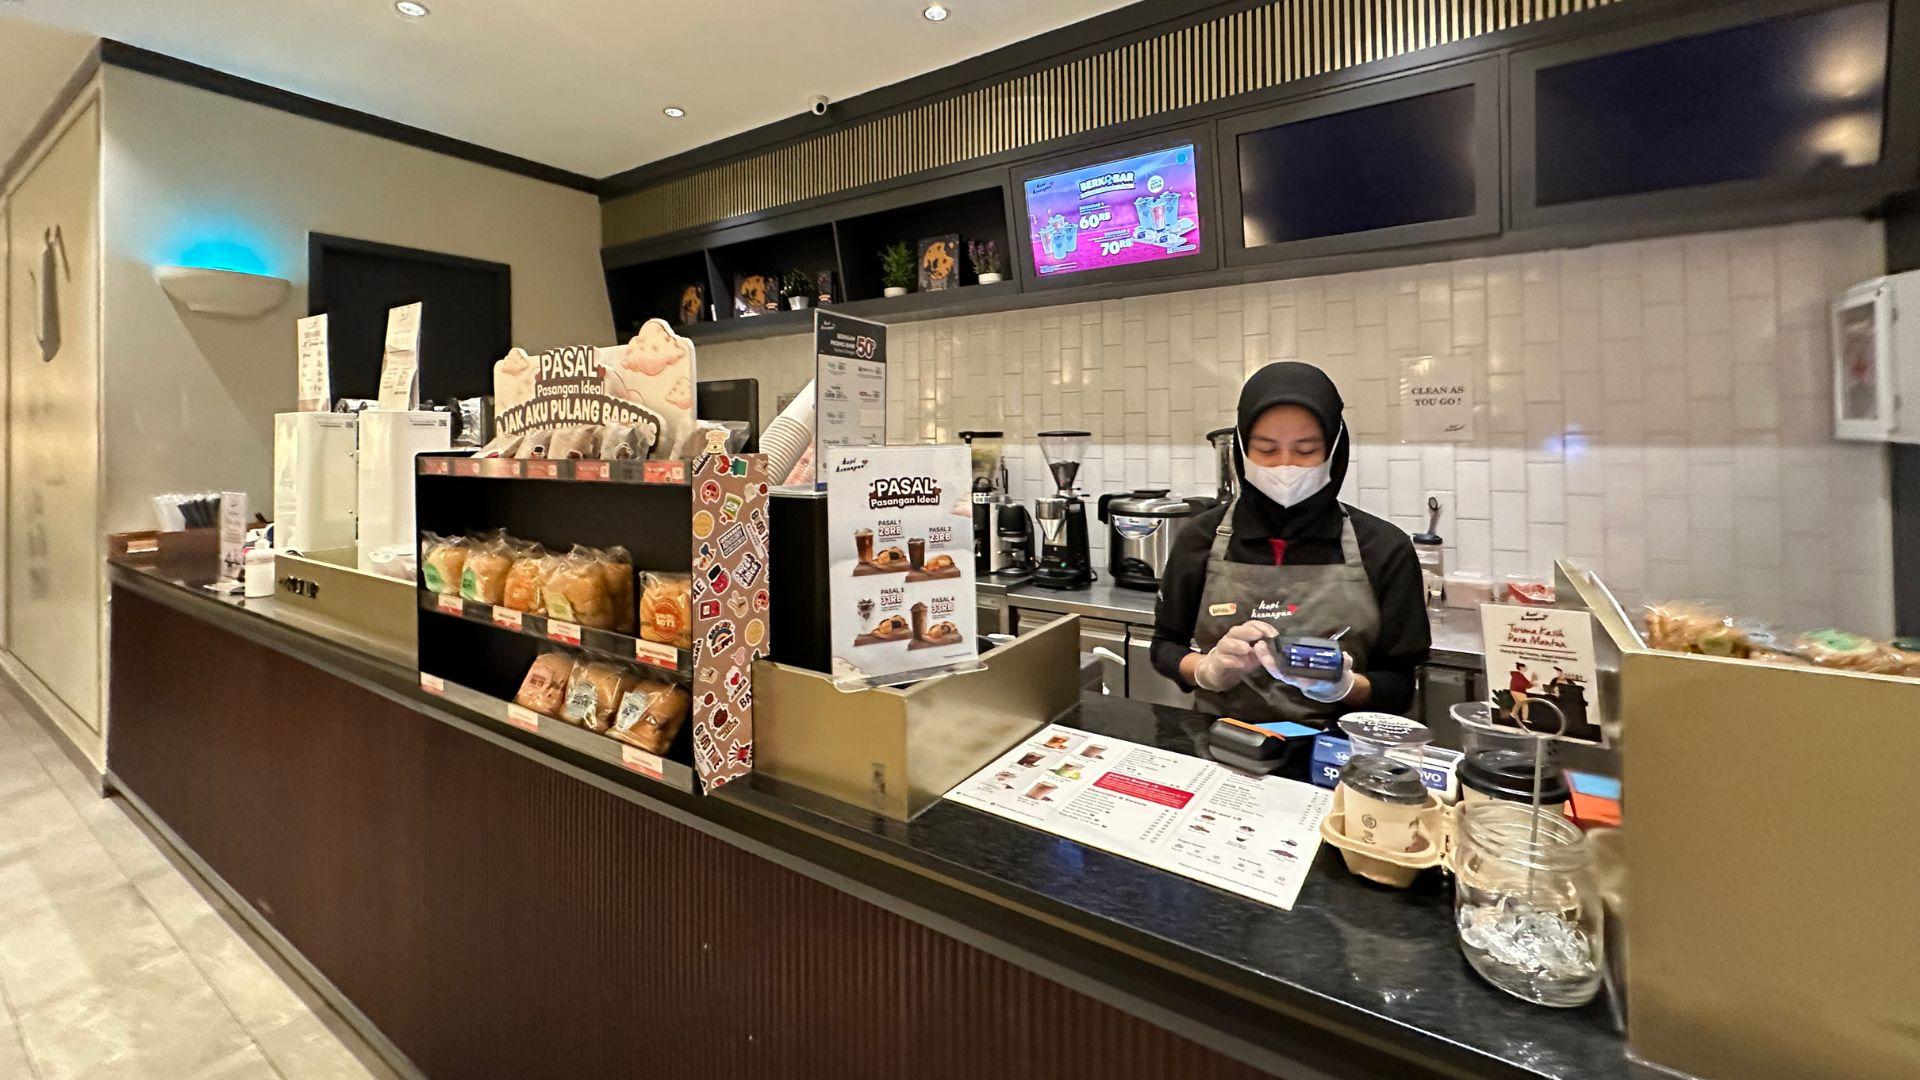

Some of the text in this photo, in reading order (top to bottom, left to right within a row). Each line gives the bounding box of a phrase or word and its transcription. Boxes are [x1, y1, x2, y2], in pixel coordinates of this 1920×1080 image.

[542, 348, 598, 380] PASAL
[537, 380, 604, 398] Pasangan Ideal
[1412, 386, 1464, 395] CLEAN AS
[526, 401, 548, 427] AKU
[550, 398, 600, 423] PULANG
[876, 479, 934, 497] PASAL
[870, 496, 938, 508] Pasangan Ideal
[879, 526, 902, 536] 28RB
[929, 532, 951, 542] 23RB
[1259, 601, 1280, 610] kopi
[1250, 608, 1292, 619] kenangan
